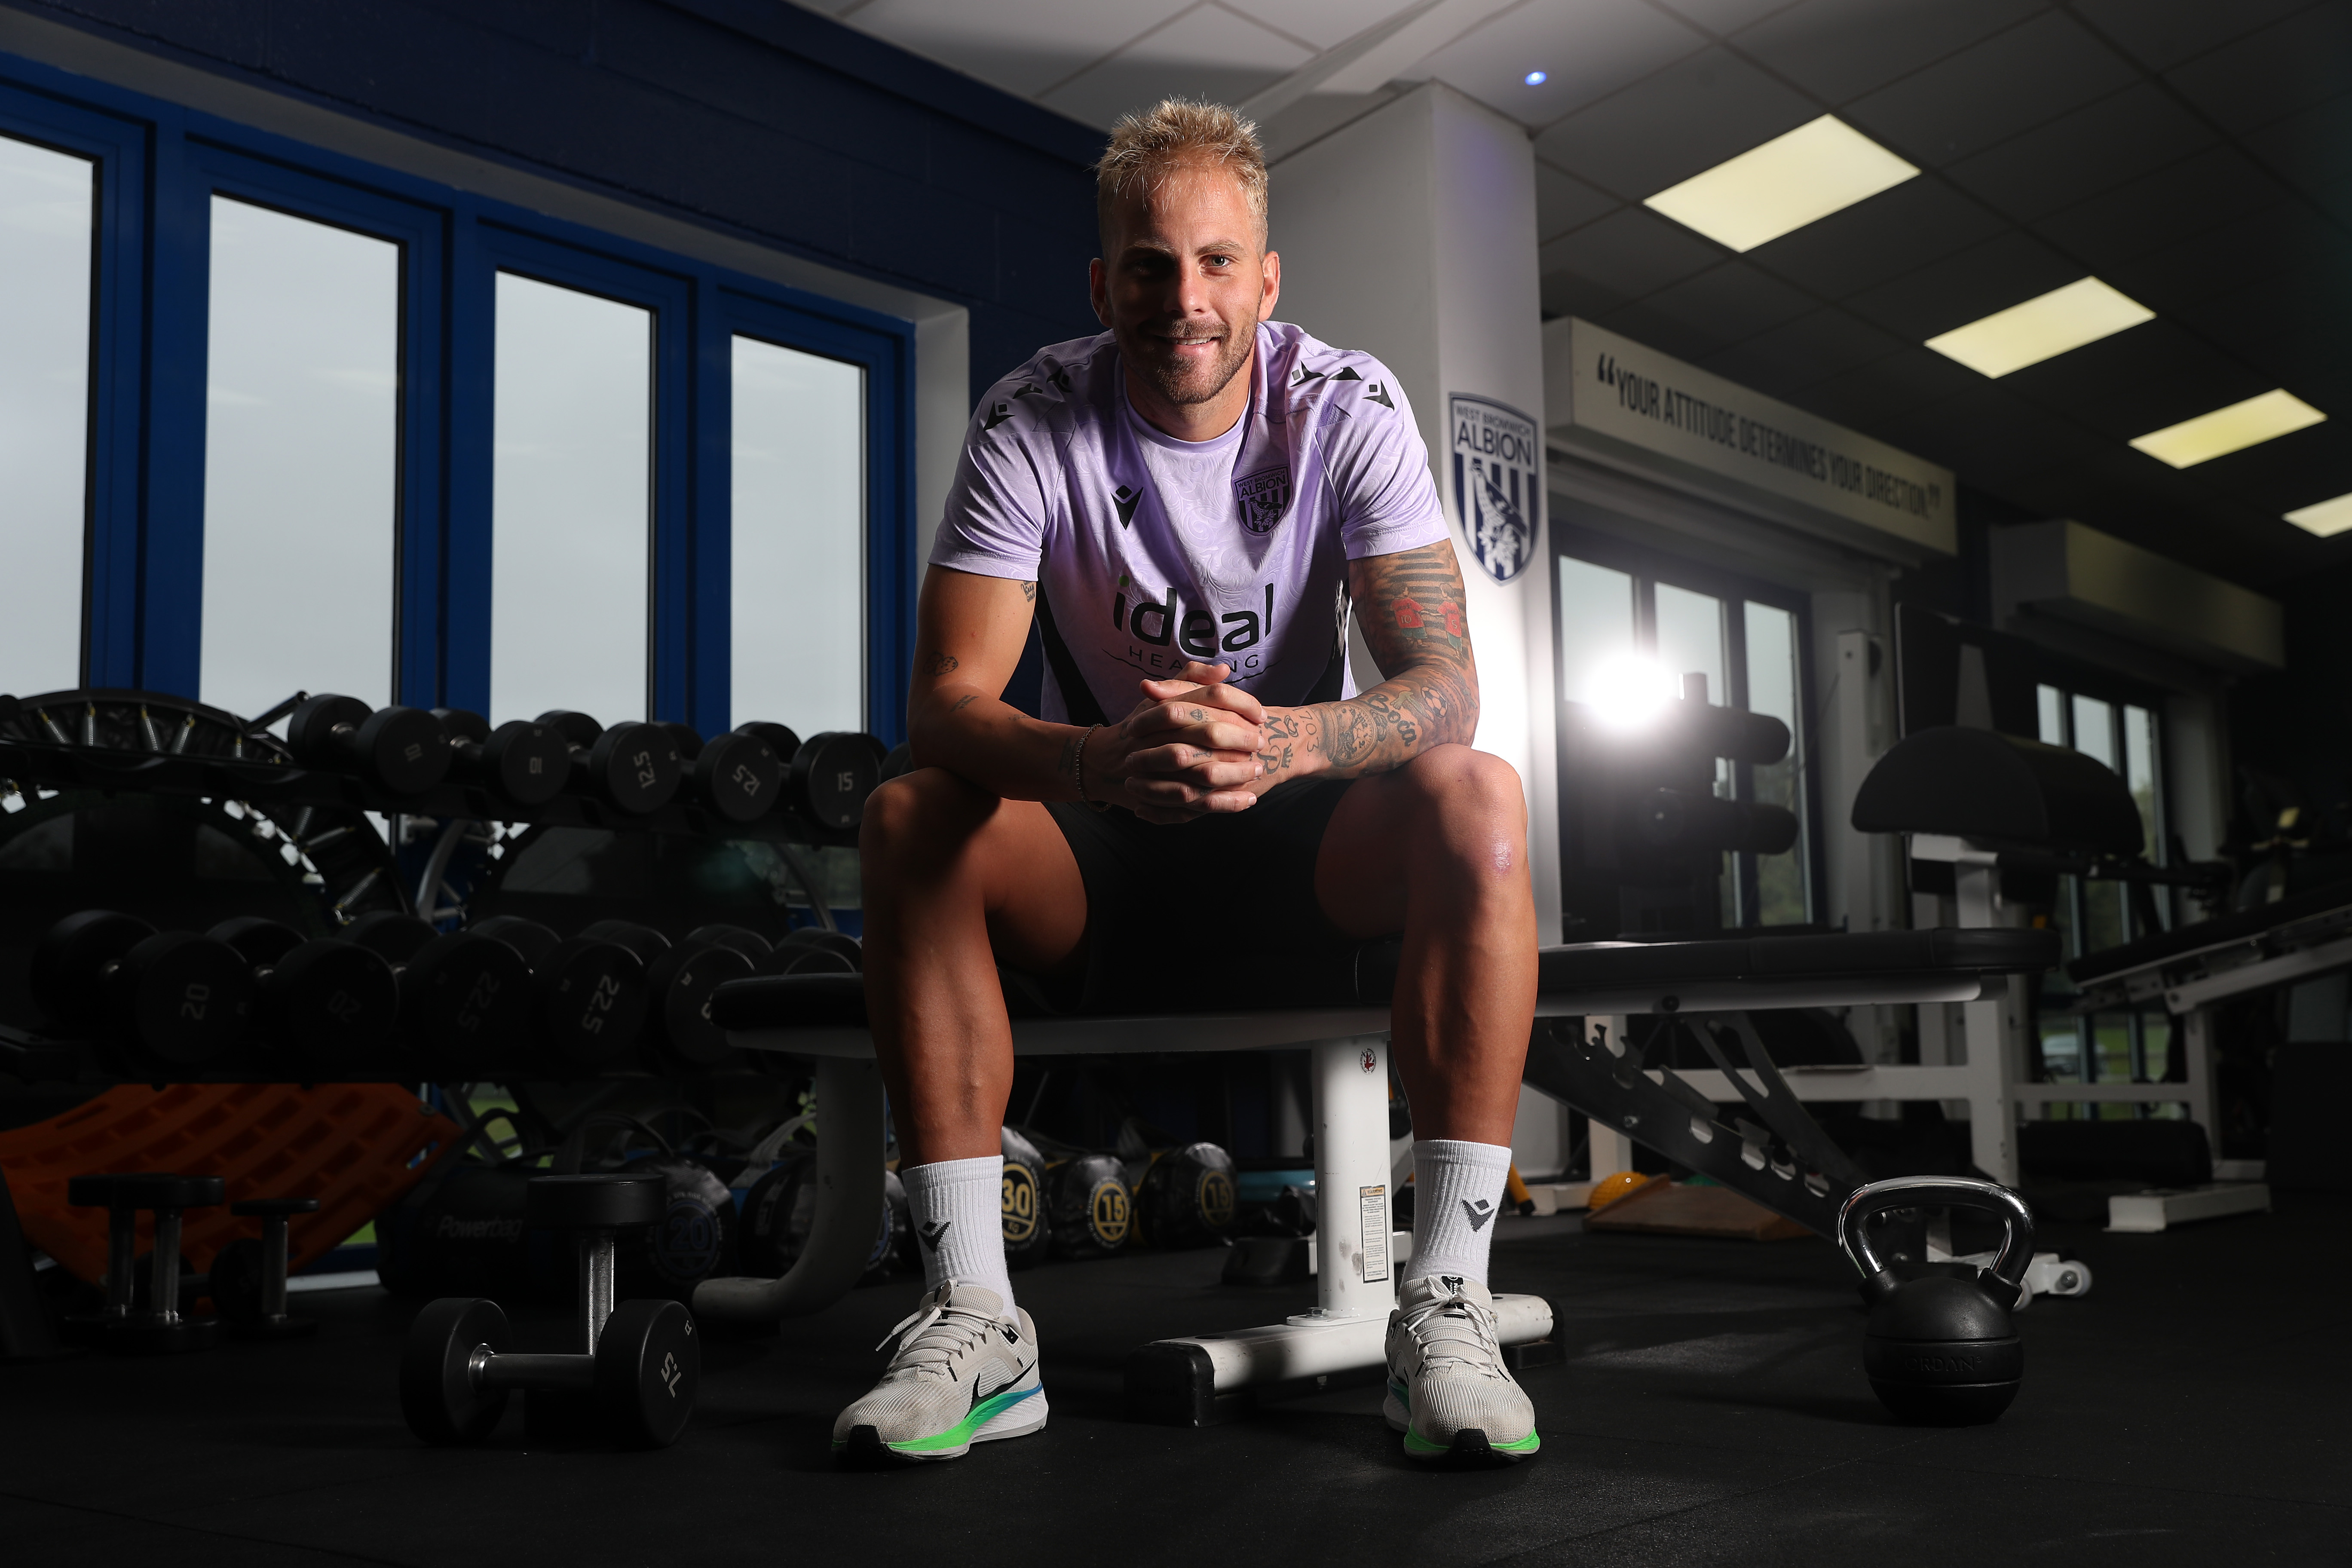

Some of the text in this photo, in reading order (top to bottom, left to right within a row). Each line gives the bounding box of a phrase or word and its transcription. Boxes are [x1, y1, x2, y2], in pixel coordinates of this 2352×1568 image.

[1456, 405, 1480, 422] WEST
[1457, 421, 1532, 466] ALBION
[1664, 387, 1737, 449] ATTITUDE
[1739, 416, 1826, 482] DETERMINES
[1828, 450, 1864, 496] YOUR
[1238, 469, 1285, 487] WEST BROMWICH
[1240, 475, 1286, 499] ALBION
[1113, 574, 1274, 658] ideal
[1129, 645, 1258, 674] HEANG
[633, 750, 657, 790] 12.5
[732, 764, 761, 796] 12.5
[837, 772, 854, 792] 15
[180, 983, 211, 1021] 20
[328, 989, 362, 1023] 20
[456, 969, 502, 1033] 22.5
[582, 973, 621, 1035] 22.5
[1002, 1178, 1031, 1218] 30
[1102, 1194, 1125, 1221] 15
[1207, 1182, 1230, 1207] 15
[436, 1214, 524, 1243] Powerbag
[669, 1216, 710, 1250] 20
